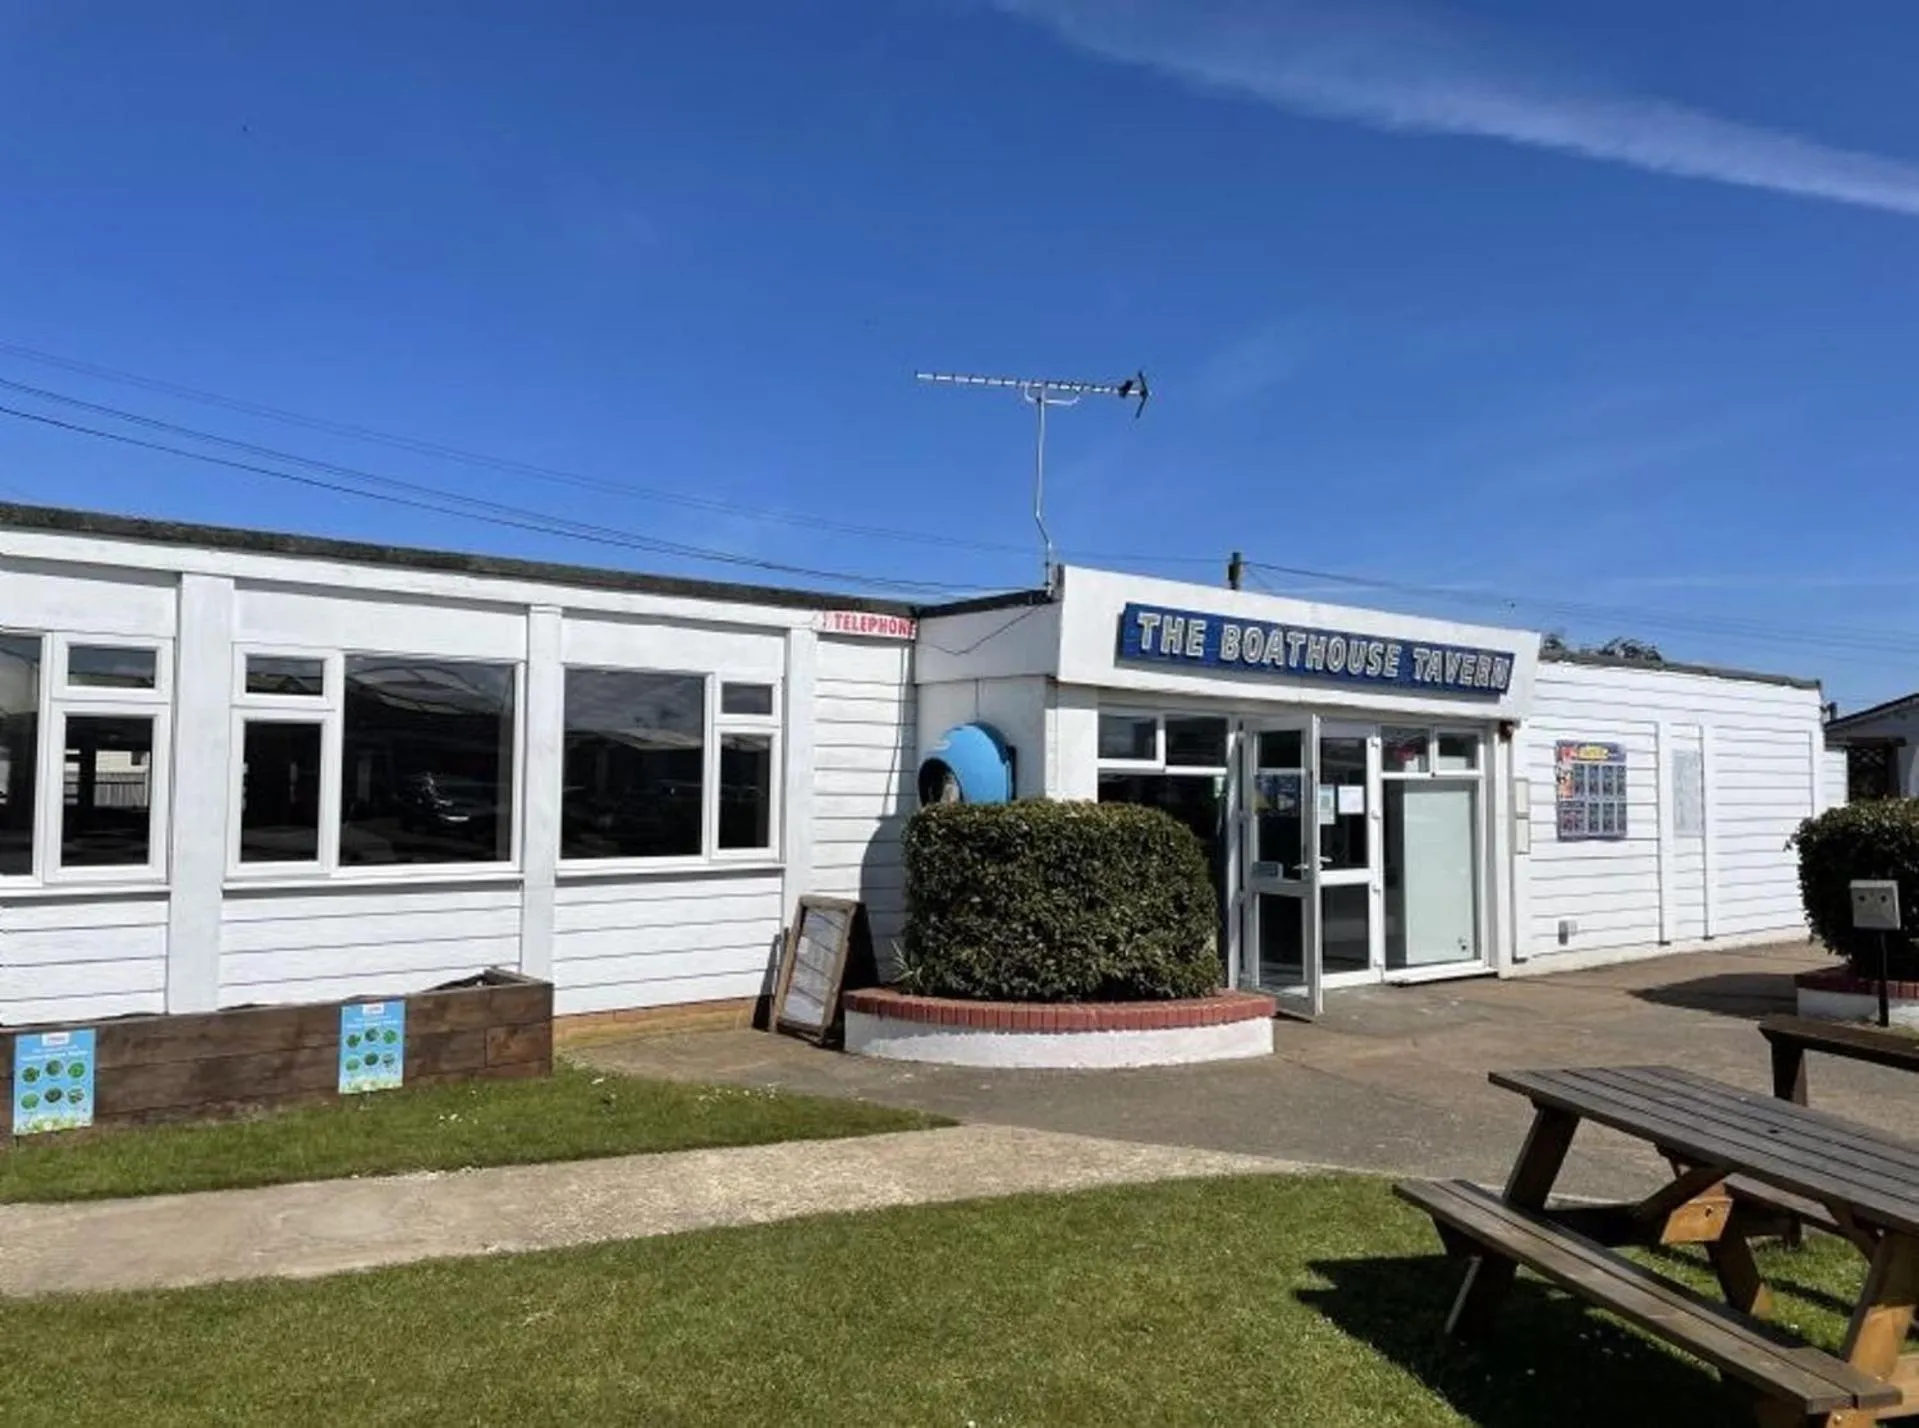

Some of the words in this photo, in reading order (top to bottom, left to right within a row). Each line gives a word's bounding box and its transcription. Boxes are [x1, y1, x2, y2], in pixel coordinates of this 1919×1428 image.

[1137, 612, 1206, 657] THE
[1219, 623, 1401, 678] BOATHOUSE
[1412, 647, 1512, 691] TAVERN
